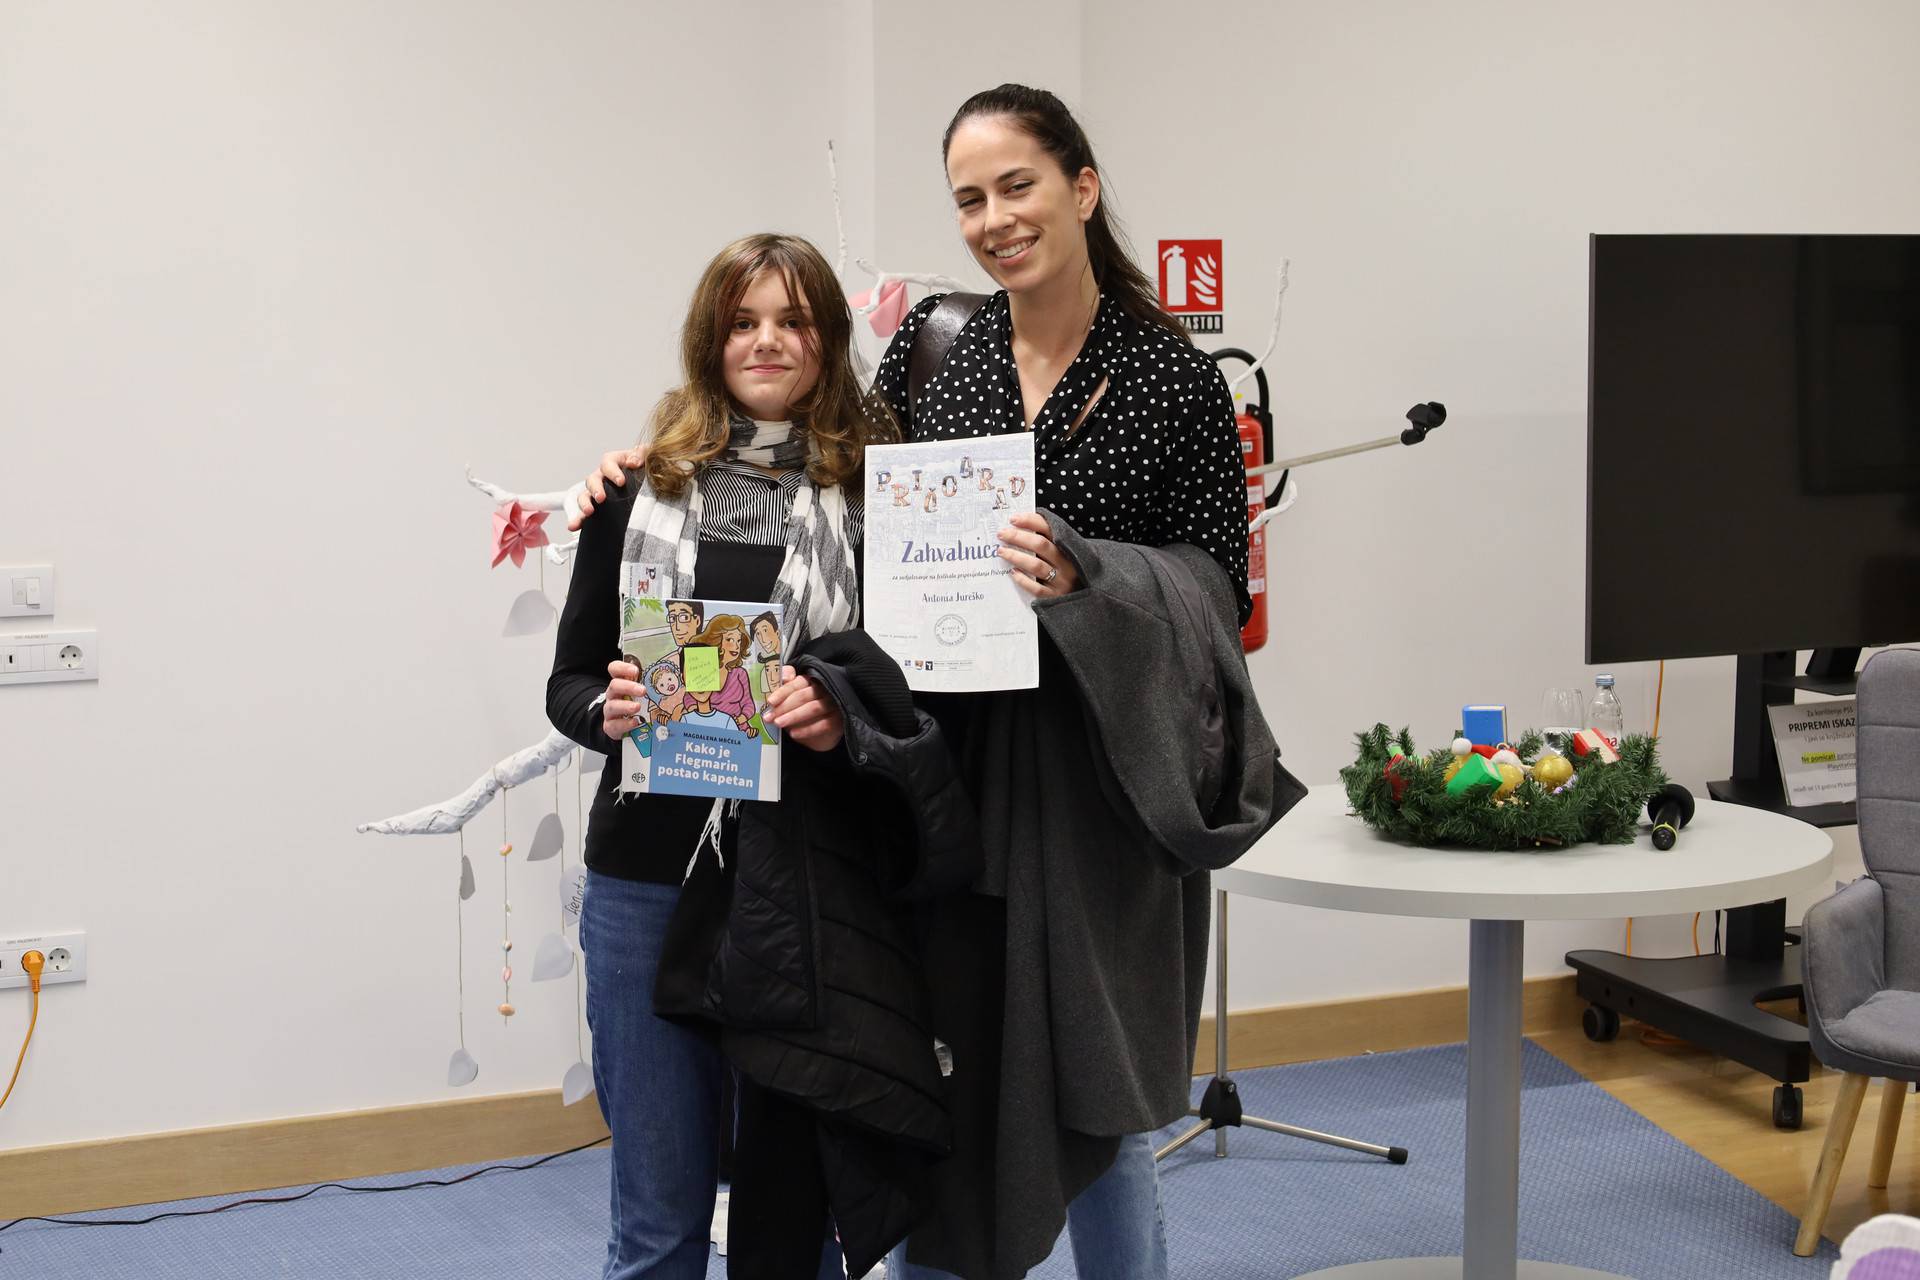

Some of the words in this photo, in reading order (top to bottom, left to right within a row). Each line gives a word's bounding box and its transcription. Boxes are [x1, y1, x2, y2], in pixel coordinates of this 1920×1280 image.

[901, 537, 1000, 563] Zahvalnica
[922, 591, 953, 603] Antonia
[955, 591, 985, 602] Jureško
[1788, 720, 1830, 733] PRIPREMI
[1832, 717, 1856, 729] ISKAZ
[683, 732, 717, 743] MAGDALENA
[685, 741, 716, 757] Kako
[717, 744, 731, 758] je
[675, 754, 739, 773] Flegmarin
[657, 764, 701, 781] postao
[702, 768, 754, 788] kapetan
